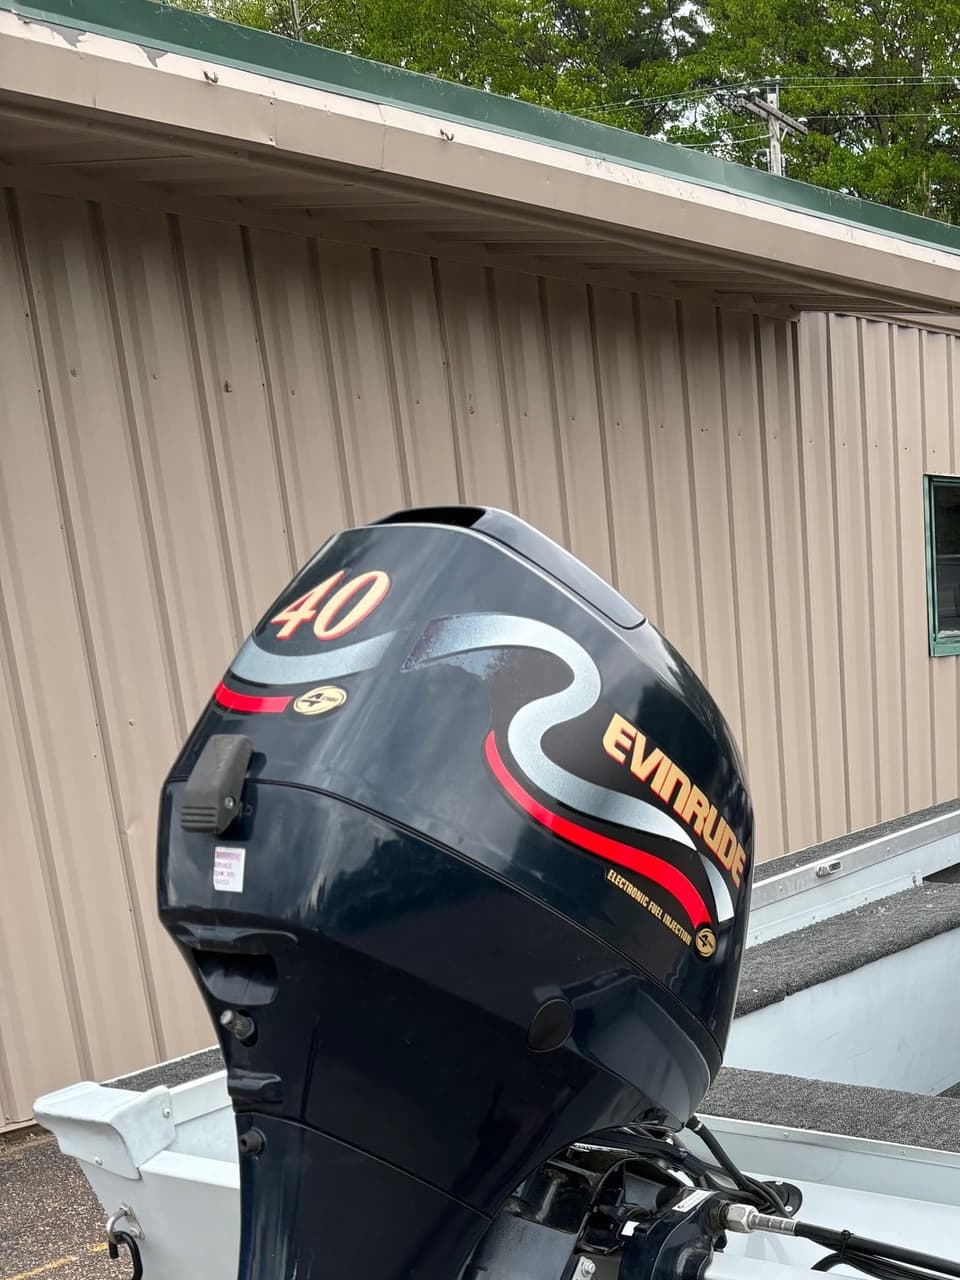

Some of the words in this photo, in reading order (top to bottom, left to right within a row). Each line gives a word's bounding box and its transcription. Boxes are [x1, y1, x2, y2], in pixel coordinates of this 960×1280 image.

[271, 570, 391, 641] 40
[602, 712, 747, 889] EVINRUDE
[607, 868, 650, 907] ELECTRONIC
[648, 900, 664, 920] FUEL
[662, 912, 693, 946] INJECTION
